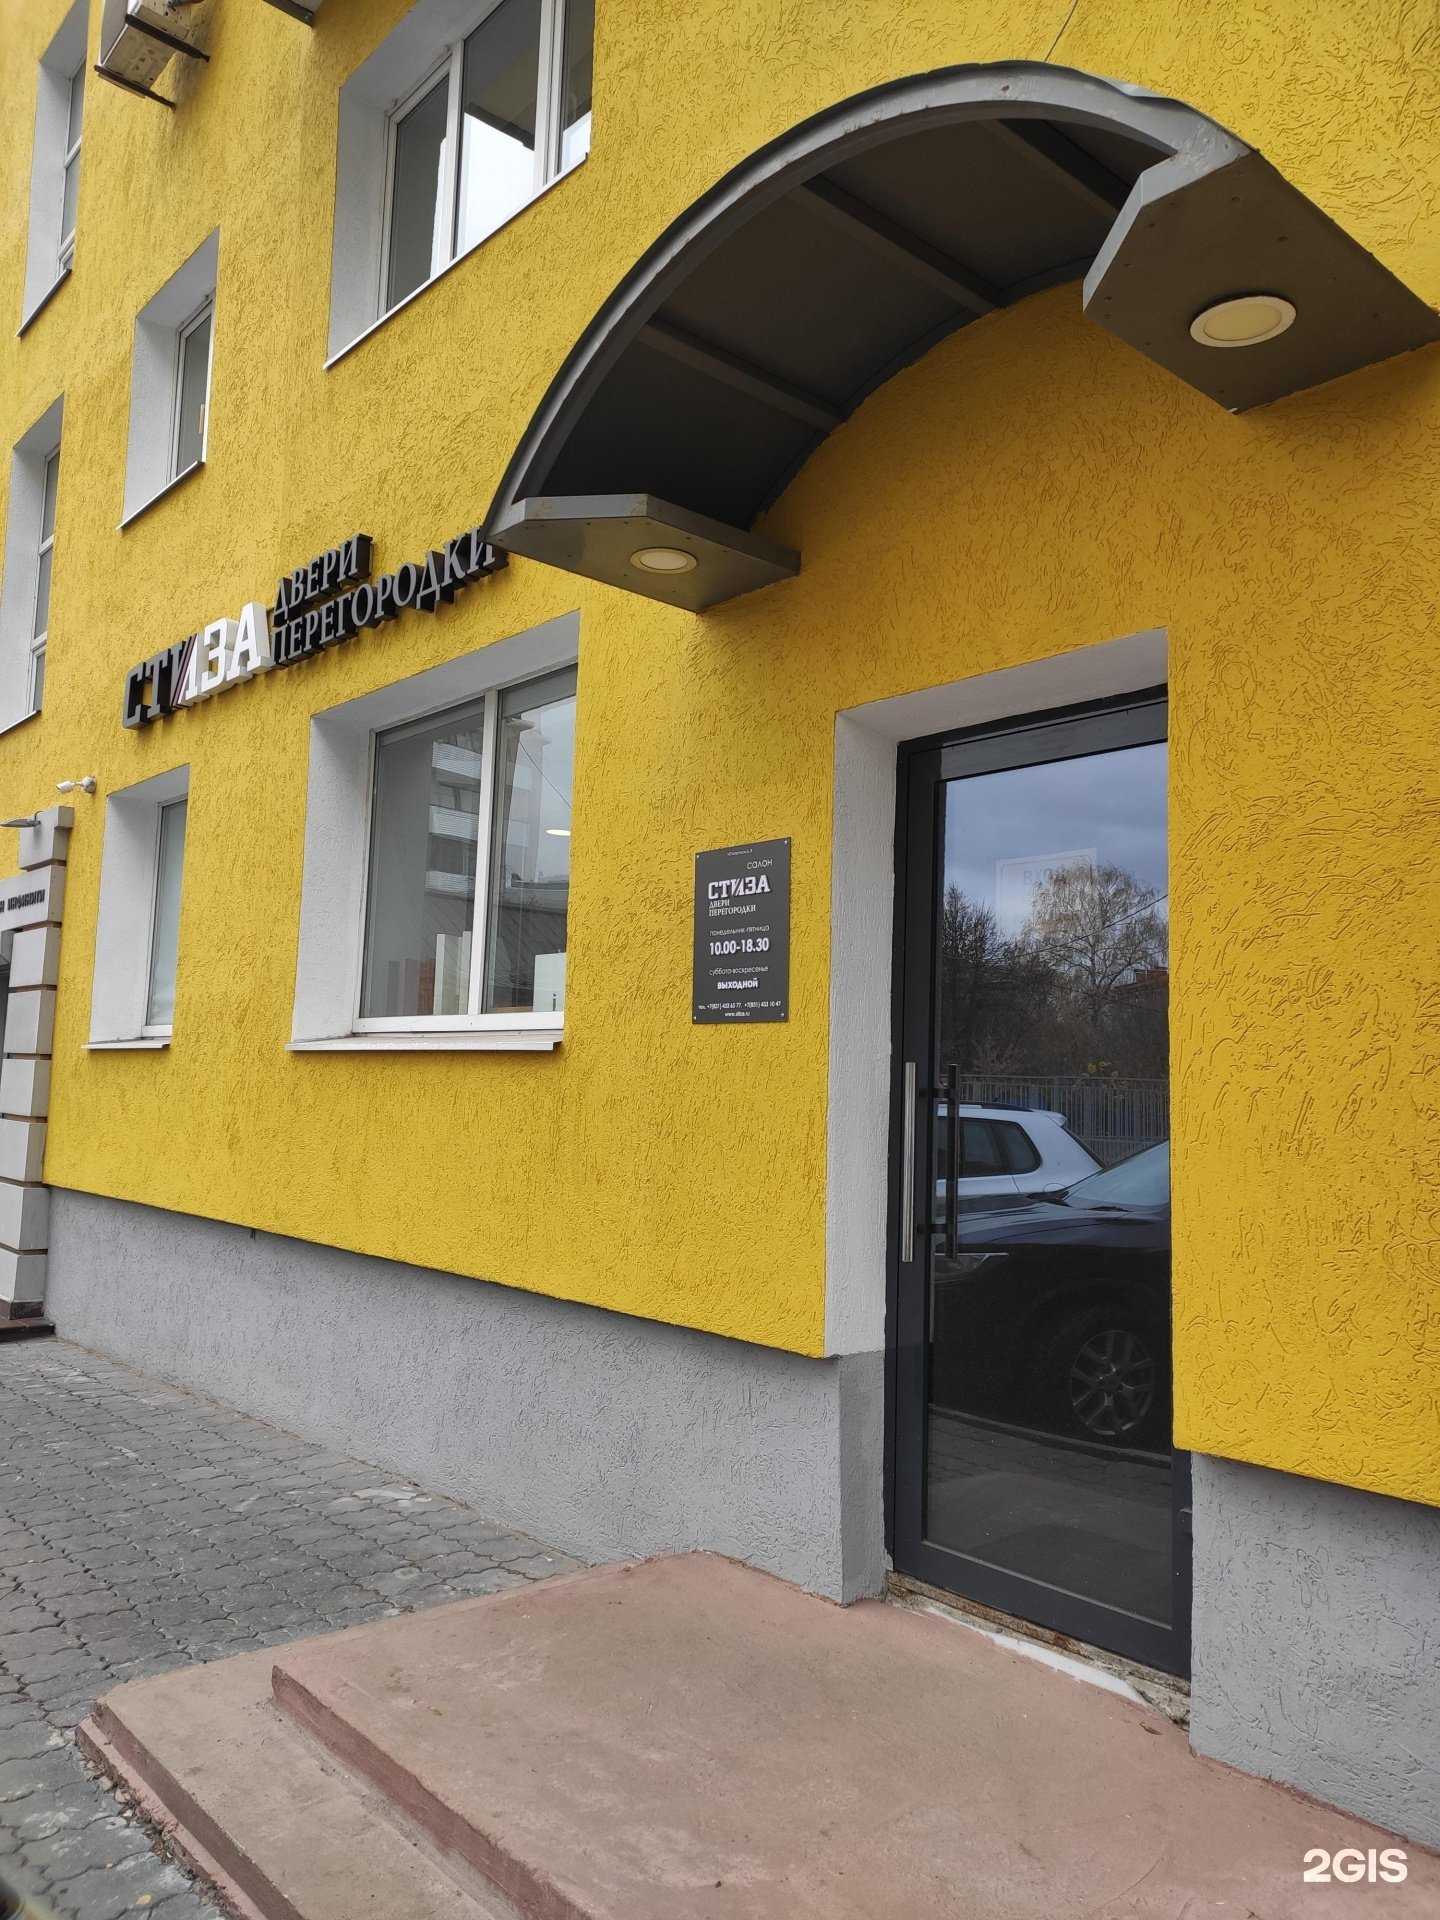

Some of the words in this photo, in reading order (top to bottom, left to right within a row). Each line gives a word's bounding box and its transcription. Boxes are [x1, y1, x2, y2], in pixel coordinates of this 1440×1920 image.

[271, 533, 362, 617] ДВЕРИ
[272, 526, 497, 665] ПЕРЕГОРОДКИ
[122, 601, 270, 730] СТИЗА
[747, 859, 773, 870] салон
[708, 874, 771, 900] СТИЗА
[709, 899, 730, 909] ДВЕРИ
[709, 905, 756, 917] ПЕРЕГОРОДКИ
[709, 937, 769, 956] 10.00-18.30
